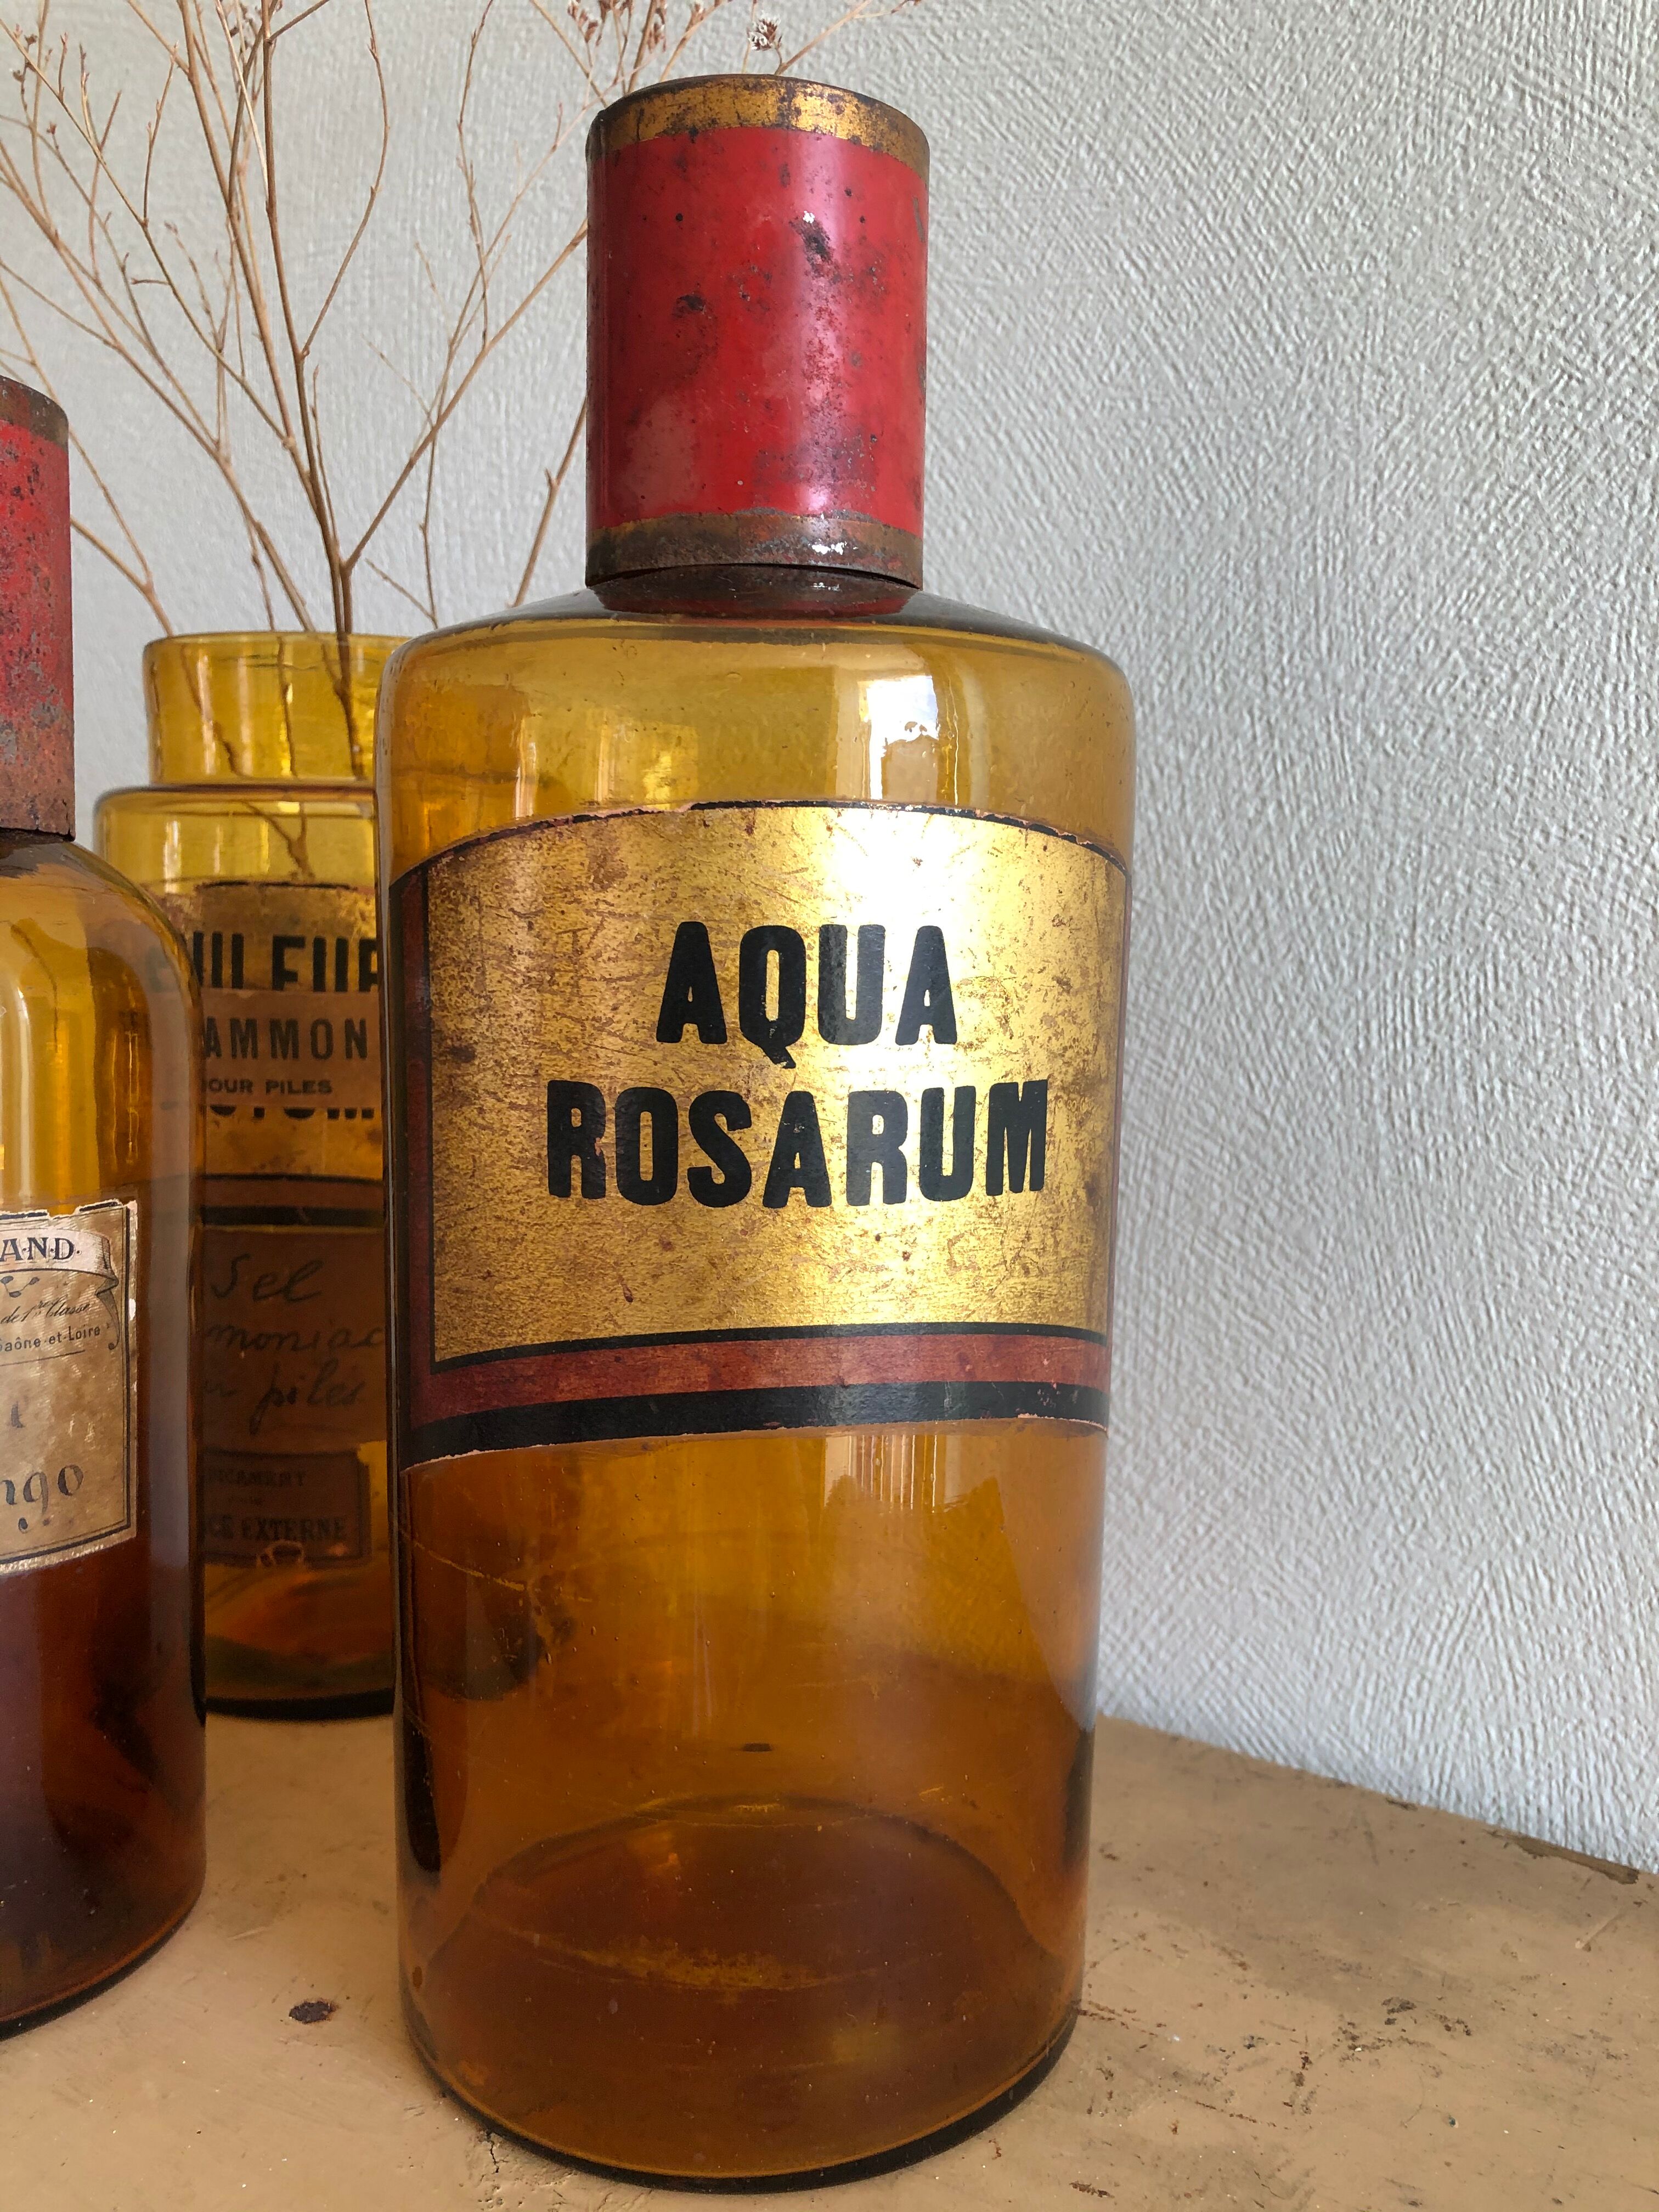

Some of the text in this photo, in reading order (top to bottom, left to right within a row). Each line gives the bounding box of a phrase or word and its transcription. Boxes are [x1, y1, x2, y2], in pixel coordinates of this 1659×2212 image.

[656, 921, 957, 1069] AQUA
[265, 1079, 334, 1094] PILES
[549, 1080, 1048, 1209] ROSARUM
[211, 1252, 326, 1304] Sel
